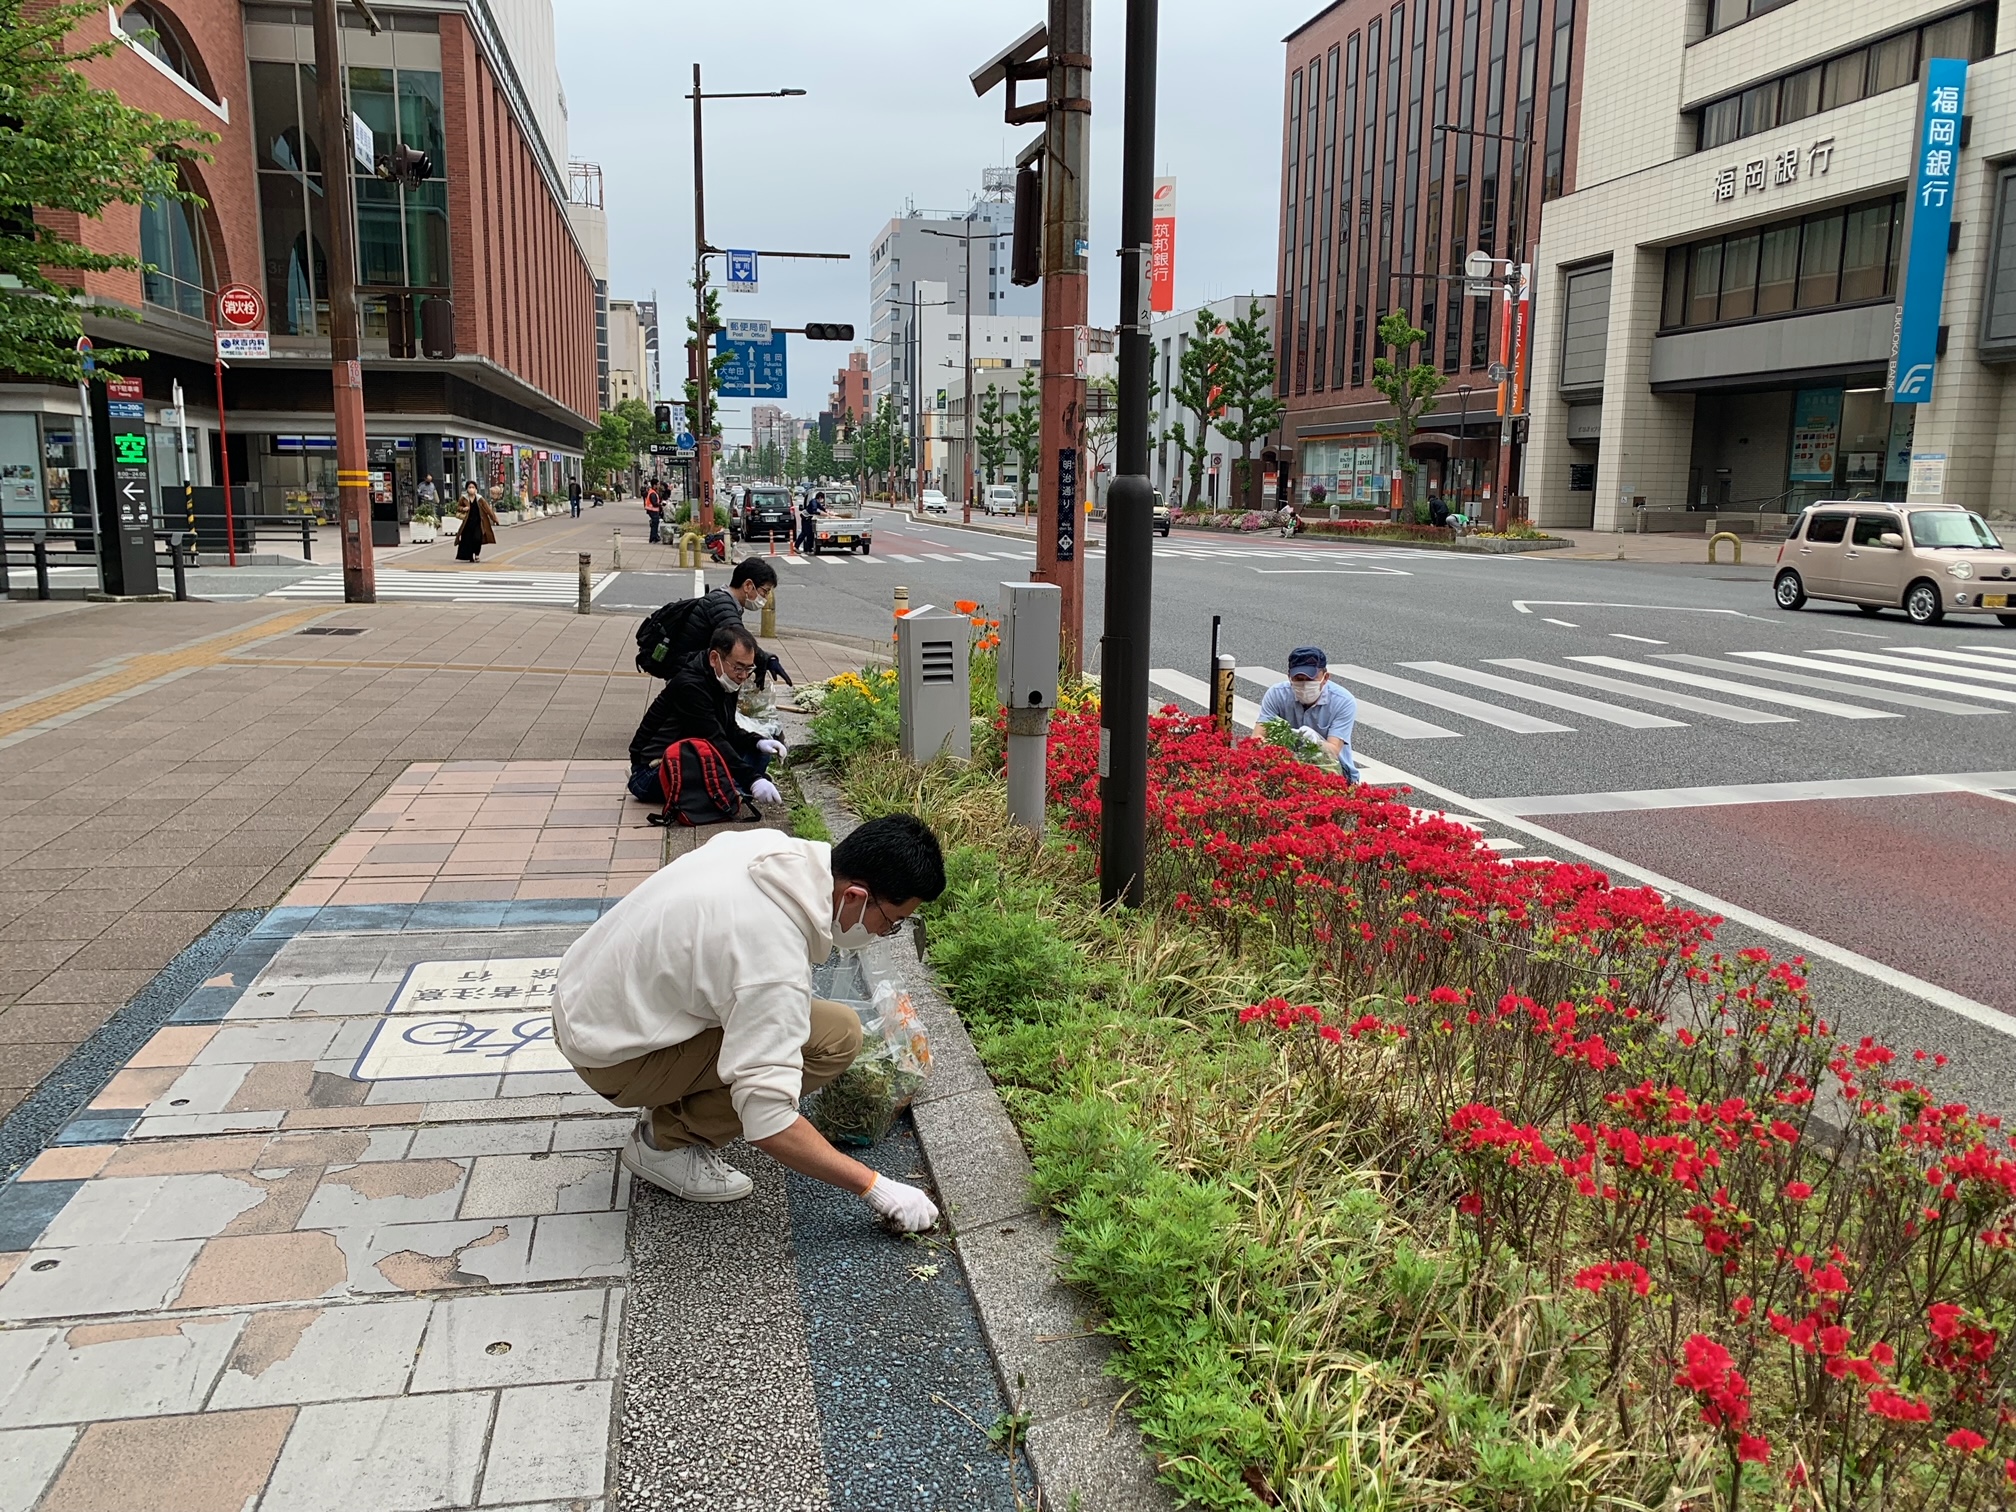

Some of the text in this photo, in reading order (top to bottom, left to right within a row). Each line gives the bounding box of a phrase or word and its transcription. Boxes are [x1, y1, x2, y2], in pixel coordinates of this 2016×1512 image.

[1922, 86, 1960, 207] 福岡銀行
[1713, 136, 1836, 202] 福岡銀行
[1153, 223, 1170, 282] 筑邦銀行
[224, 300, 255, 315] 消火栓
[730, 321, 768, 332] 郵便局前
[1891, 306, 1902, 357] FUKUOKA
[232, 338, 265, 346] 秋吉内科
[763, 353, 783, 362] 福岡
[1077, 358, 1084, 372] R
[720, 367, 744, 376] 大牟田
[1887, 361, 1896, 390] BANK
[115, 433, 147, 463] 空
[1062, 460, 1072, 509] 明治通り
[458, 971, 493, 982] 行
[412, 984, 556, 1001] 行者注意
